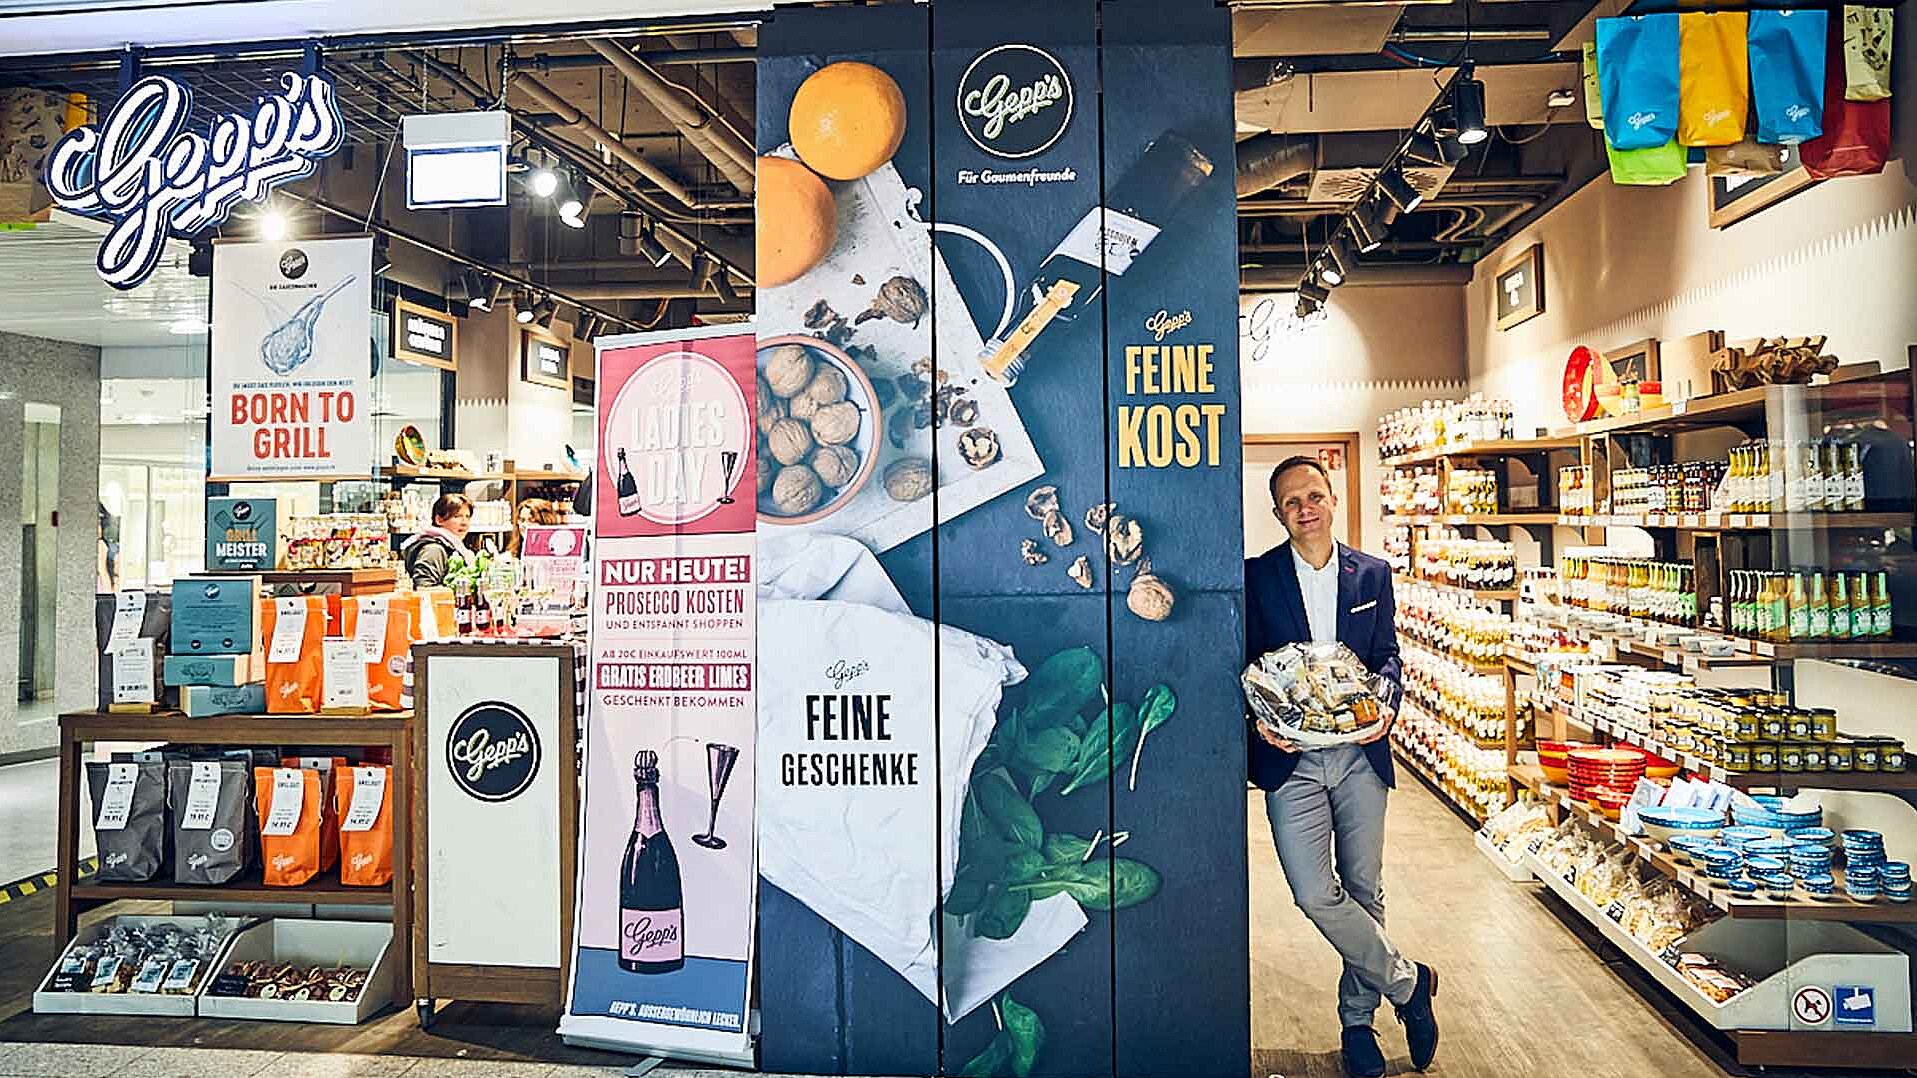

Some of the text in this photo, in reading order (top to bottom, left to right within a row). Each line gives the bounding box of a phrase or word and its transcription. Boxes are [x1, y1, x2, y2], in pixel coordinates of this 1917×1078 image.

[965, 74, 1063, 139] Gepp's
[46, 71, 344, 290] Gepp's
[958, 167, 1077, 187] Für Gaumenfreunde
[1146, 310, 1193, 342] Gepp's
[1125, 345, 1216, 395] FEINE
[231, 391, 355, 425] BORN TO
[630, 400, 726, 451] LADIES
[1118, 404, 1226, 468] KOST
[253, 427, 331, 460] GRILL
[647, 452, 709, 506] DAY
[215, 542, 268, 558] MEISTER
[604, 561, 656, 584] NUR
[660, 558, 746, 582] HEUTE!
[605, 588, 744, 615] PROSECCO KOSTEN
[606, 618, 743, 630] UND ENTSPANNT SHOPPEN
[602, 650, 616, 659] AB
[638, 649, 714, 659] EINKAUFSWERT
[600, 665, 748, 689] GRATIS ERDBEER LIMES
[602, 695, 744, 707] GESCHENKT BEKOMMEN
[805, 694, 892, 741] FEINE
[453, 728, 530, 782] Gepp's
[781, 753, 919, 787] GESCHENKE
[623, 916, 678, 956] Gepp's
